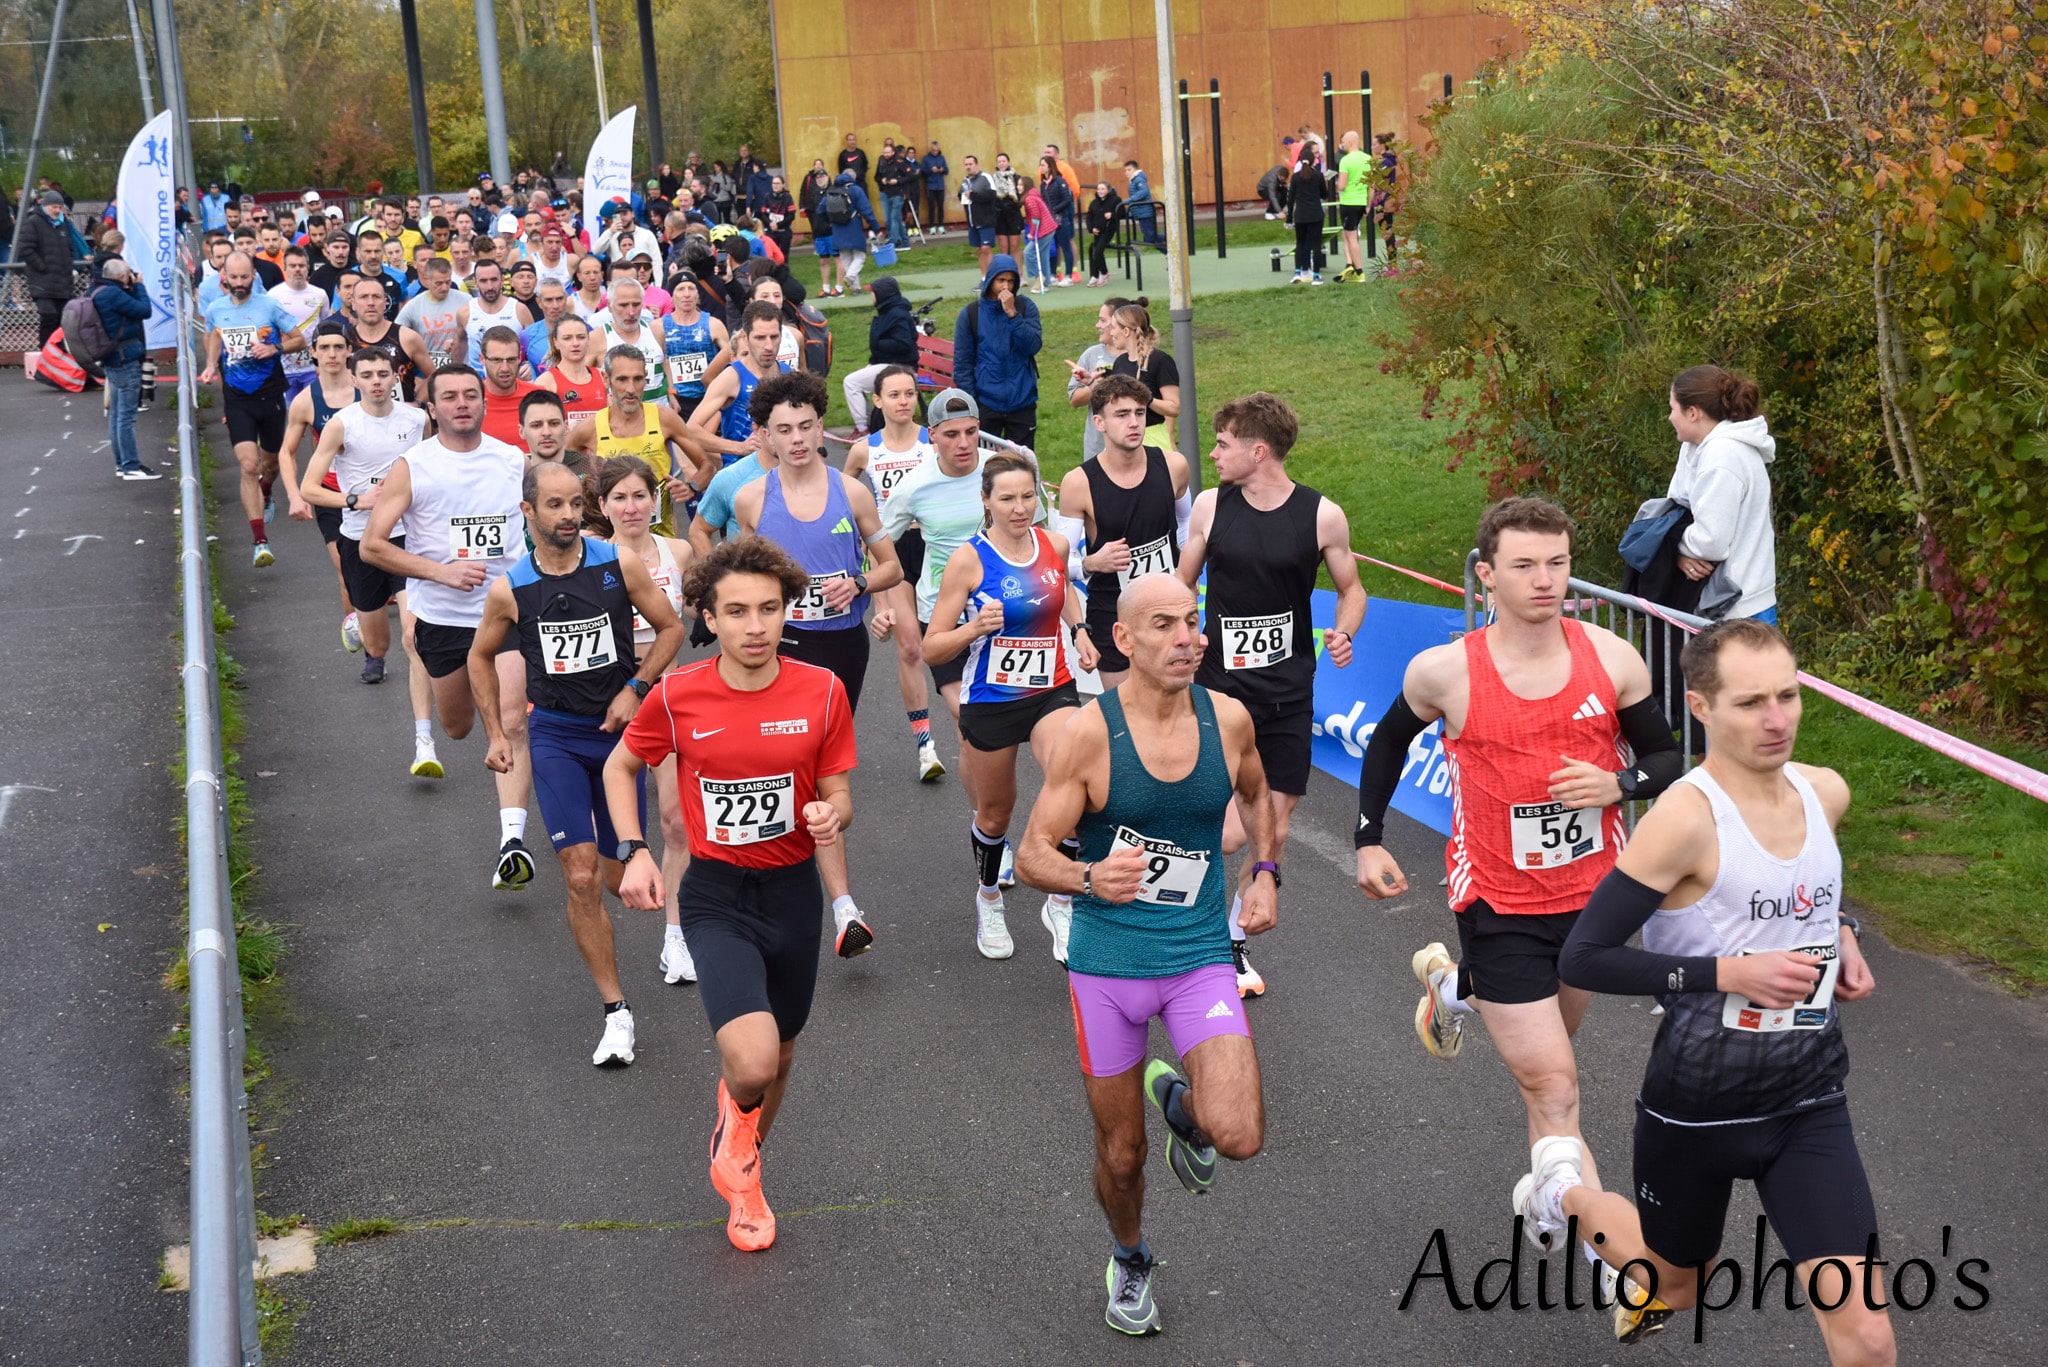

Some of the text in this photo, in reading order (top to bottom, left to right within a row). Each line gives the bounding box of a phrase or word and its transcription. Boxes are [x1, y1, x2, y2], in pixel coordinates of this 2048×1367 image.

[156, 189, 170, 263] Somme
[158, 269, 170, 292] de
[227, 333, 251, 347] 327
[677, 360, 702, 375] 134
[882, 468, 914, 489] 62
[475, 516, 505, 524] SAISONS
[462, 525, 501, 547] 163
[1139, 539, 1166, 555] SAISONS
[1128, 549, 1165, 580] 271
[545, 619, 606, 633] LES 4 SAISONS
[1252, 617, 1288, 627] SAISONS
[552, 630, 601, 659] 277
[1022, 640, 1053, 648] SAISONS
[1234, 628, 1283, 654] 268
[1000, 649, 1046, 674] 671
[706, 779, 787, 793] LES 4 SAISONS
[715, 792, 780, 827] 229
[1519, 807, 1541, 817] LES
[1543, 806, 1551, 814] 4
[1541, 812, 1582, 849] 56
[1124, 833, 1145, 848] LES
[1147, 843, 1154, 851] 4
[1145, 856, 1170, 884] 9
